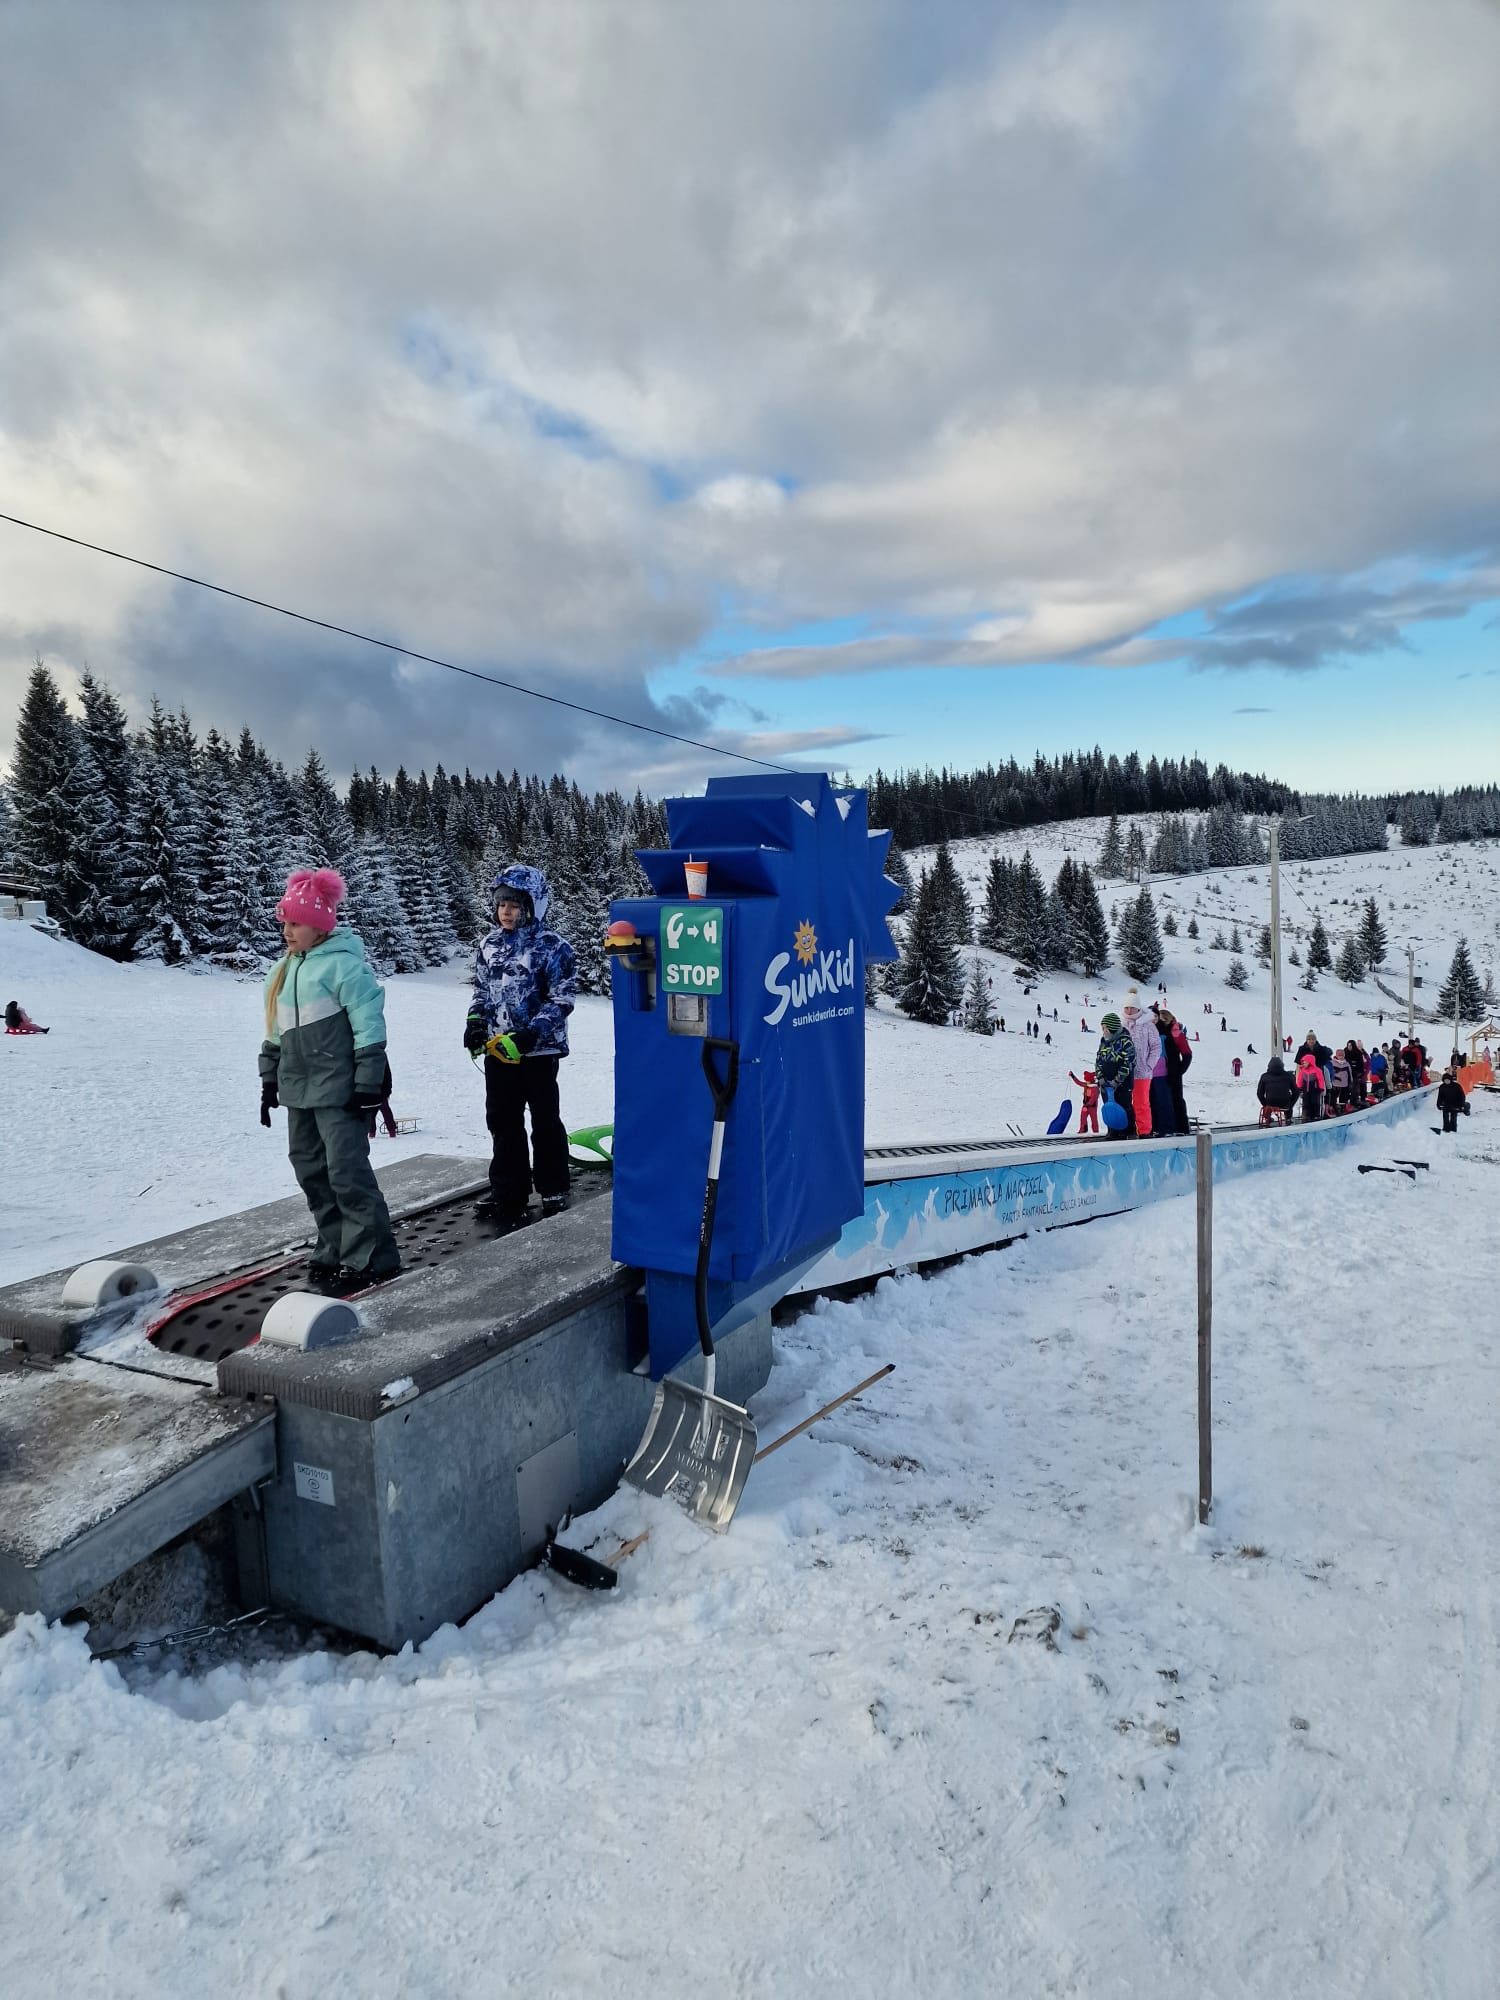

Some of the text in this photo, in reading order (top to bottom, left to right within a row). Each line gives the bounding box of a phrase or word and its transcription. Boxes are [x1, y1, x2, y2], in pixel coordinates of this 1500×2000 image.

[666, 964, 720, 986] STOP
[792, 1006, 855, 1028] sunkidworld.com
[945, 1184, 1002, 1213] PRIMARIA
